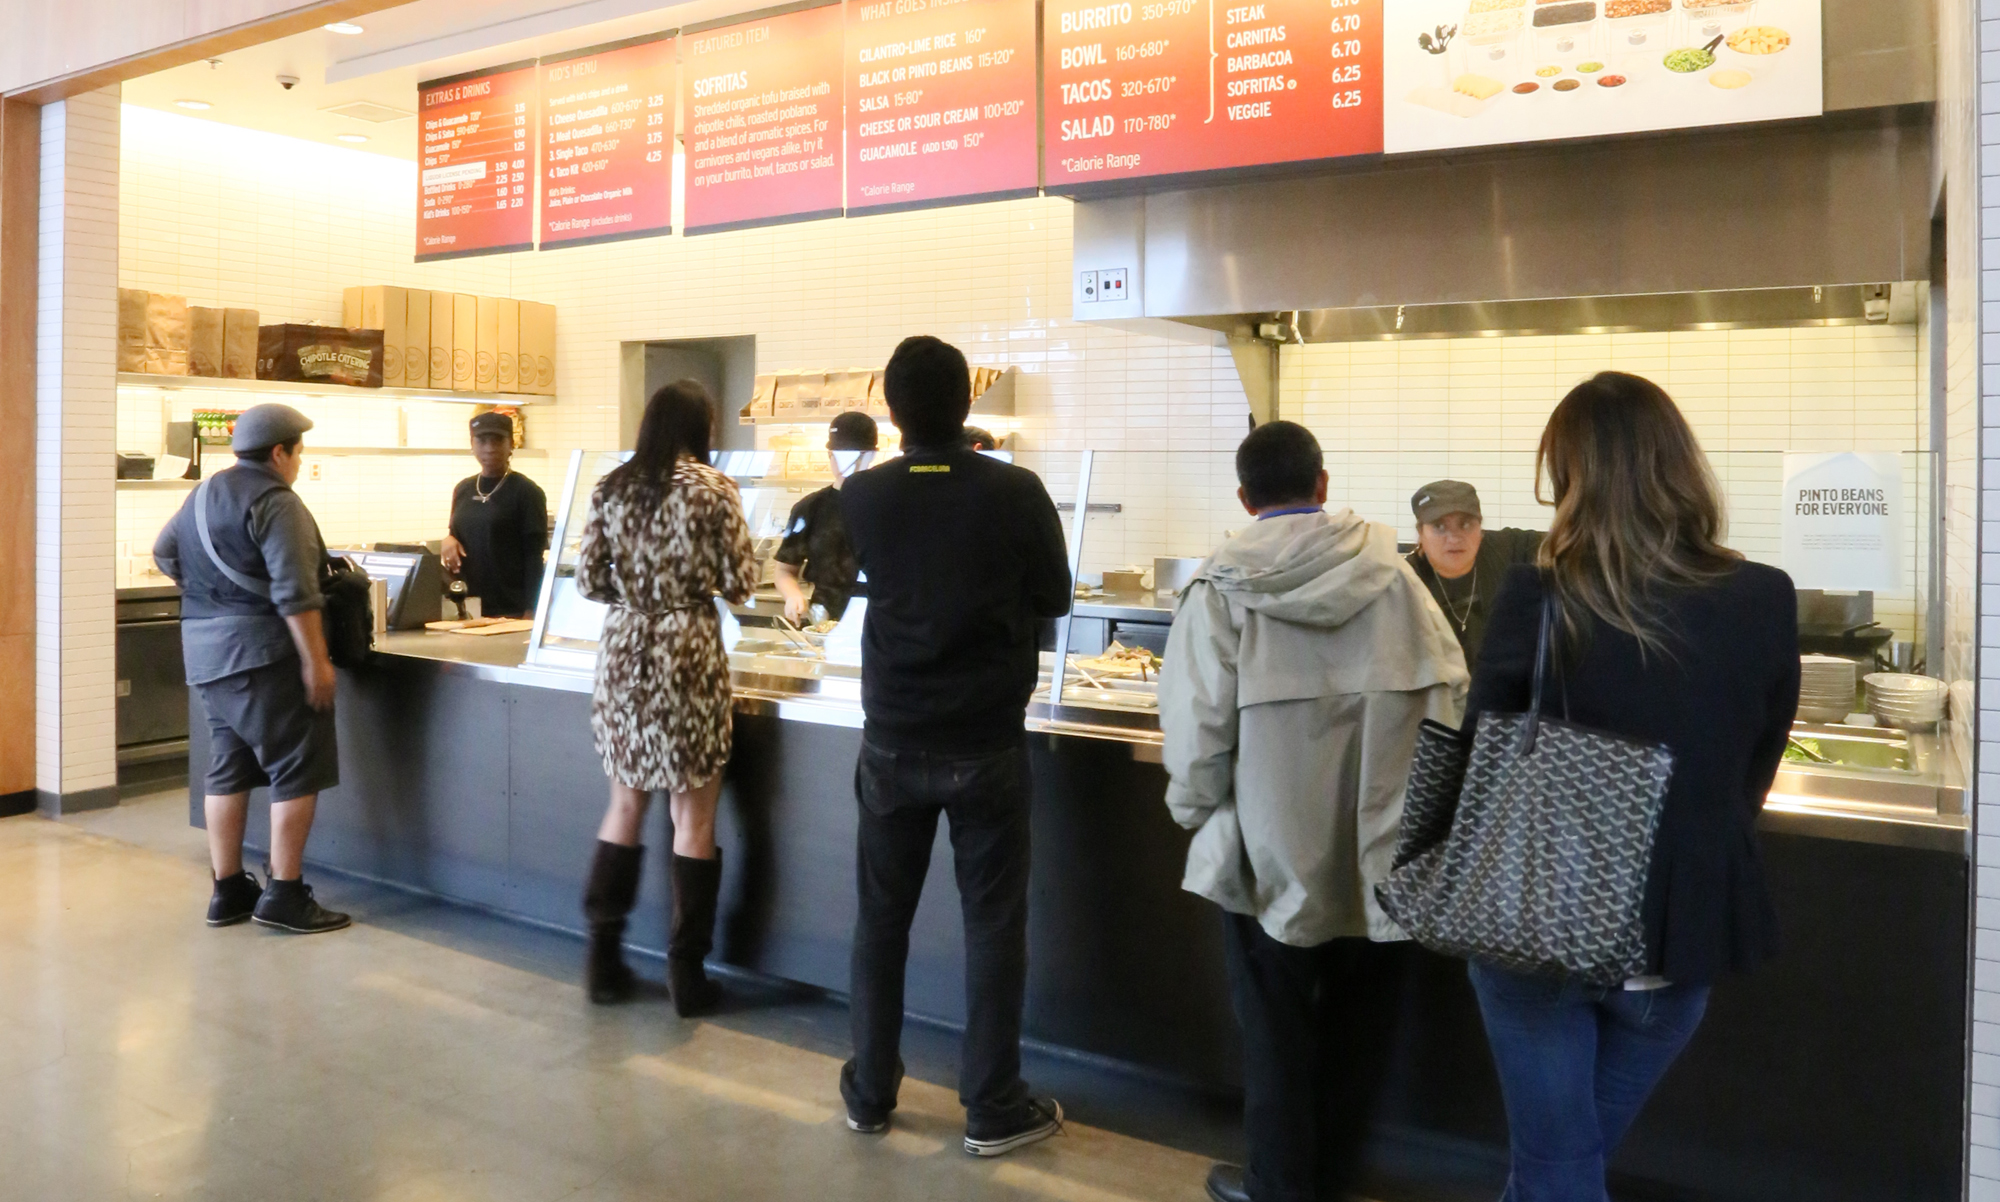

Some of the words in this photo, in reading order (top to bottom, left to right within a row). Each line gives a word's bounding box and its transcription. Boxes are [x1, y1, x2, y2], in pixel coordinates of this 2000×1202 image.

[860, 2, 892, 21] WHAT
[896, 0, 926, 14] GOES
[1061, 2, 1132, 33] BURRITO
[1226, 4, 1265, 25] STEAK
[693, 32, 742, 55] FEATURED
[746, 26, 770, 44] ITEM
[1227, 26, 1286, 48] CARNITAS
[1331, 14, 1360, 33] 6.70
[859, 37, 931, 63] CILANTRO-LIME
[934, 33, 956, 49] RICE
[1061, 43, 1107, 69] BOWL
[1227, 50, 1293, 73] BARBACOA
[1331, 39, 1361, 58] 6.70
[549, 66, 570, 82] KID'S
[573, 60, 597, 77] MENU
[860, 71, 890, 87] BLACK
[892, 68, 906, 82] OR
[908, 62, 937, 79] PINTO
[940, 56, 973, 75] BEANS
[1227, 75, 1284, 97] SOFRITAS
[1332, 65, 1361, 84] 6.25
[426, 89, 453, 106] EXTRAS
[455, 88, 460, 100] &
[463, 81, 490, 98] DRINKS
[694, 71, 748, 98] SOFRITAS
[1060, 78, 1112, 105] TACOS
[648, 94, 664, 108] 3.25
[694, 99, 730, 118] Shredded
[732, 94, 760, 115] organic
[762, 91, 778, 106] tofu
[780, 85, 810, 102] braised
[812, 81, 830, 96] with
[860, 95, 889, 112] SALSA
[1228, 102, 1272, 121] VEGGIE
[1332, 90, 1361, 109] 6.25
[647, 113, 663, 126] 3.75
[694, 118, 724, 136] chipotle
[748, 108, 778, 125] roasted
[780, 103, 817, 122] poblanos
[860, 119, 895, 137] CHEESE
[898, 117, 911, 131] OR
[914, 113, 941, 129] SOUR
[944, 107, 978, 124] CREAM
[1060, 115, 1114, 142] SALAD
[575, 146, 588, 157] Taco
[646, 132, 662, 144] 3.75
[694, 138, 709, 152] and
[710, 138, 715, 150] a
[716, 132, 737, 148] blend
[739, 130, 747, 145] of
[748, 125, 784, 143] aromatic
[785, 122, 812, 140] spices.
[814, 119, 828, 133] For
[556, 167, 570, 177] Taco
[646, 150, 662, 163] 4.25
[694, 152, 734, 169] carnivores
[735, 148, 750, 163] and
[751, 146, 779, 162] vegans
[781, 140, 802, 156] alike,
[803, 139, 816, 155] try
[817, 137, 823, 150] it
[860, 141, 917, 162] GUACAMOLE
[922, 142, 940, 154] (ADD
[1107, 154, 1141, 169] Range
[495, 162, 507, 172] 3.50
[512, 159, 525, 169] 4.00
[496, 174, 508, 184] 2.25
[512, 172, 524, 182] 2.50
[694, 174, 705, 186] on
[706, 171, 723, 187] your
[754, 163, 775, 177] bowl,
[776, 160, 798, 174] tacos
[800, 159, 809, 171] or
[810, 153, 834, 169] salad.
[497, 187, 508, 197] 1.60
[513, 185, 524, 194] 1.90
[891, 181, 915, 193] Range
[511, 198, 523, 208] 2.20
[572, 218, 590, 229] Range
[300, 353, 337, 366] CHIPOTLE
[338, 354, 370, 369] CATERING
[1800, 489, 1838, 502] PINTO
[1842, 489, 1884, 502] BEANS
[1795, 503, 1819, 516] FOR
[1822, 503, 1888, 516] EVERYONE
